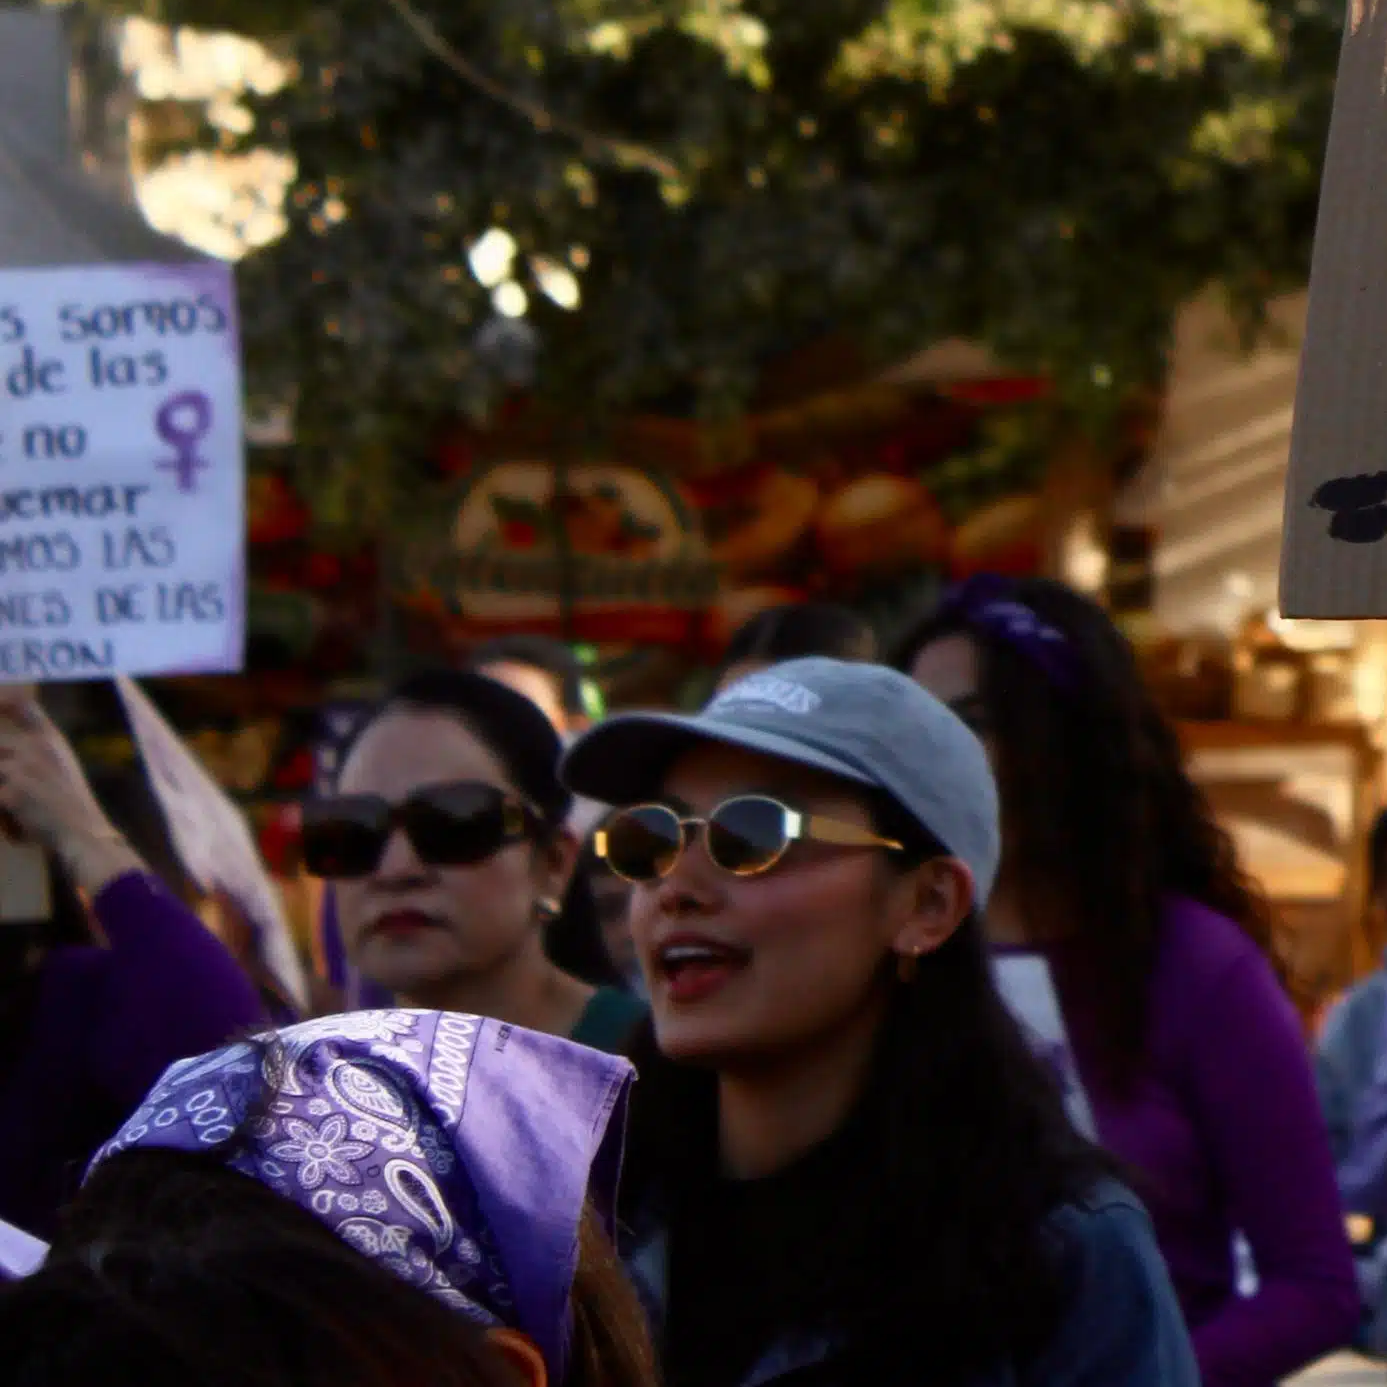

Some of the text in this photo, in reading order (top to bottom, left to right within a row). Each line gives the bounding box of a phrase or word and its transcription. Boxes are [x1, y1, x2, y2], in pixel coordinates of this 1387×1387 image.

[6, 343, 169, 398] de las
[23, 421, 88, 460] no
[102, 525, 177, 571] LAS
[96, 582, 148, 627] DE
